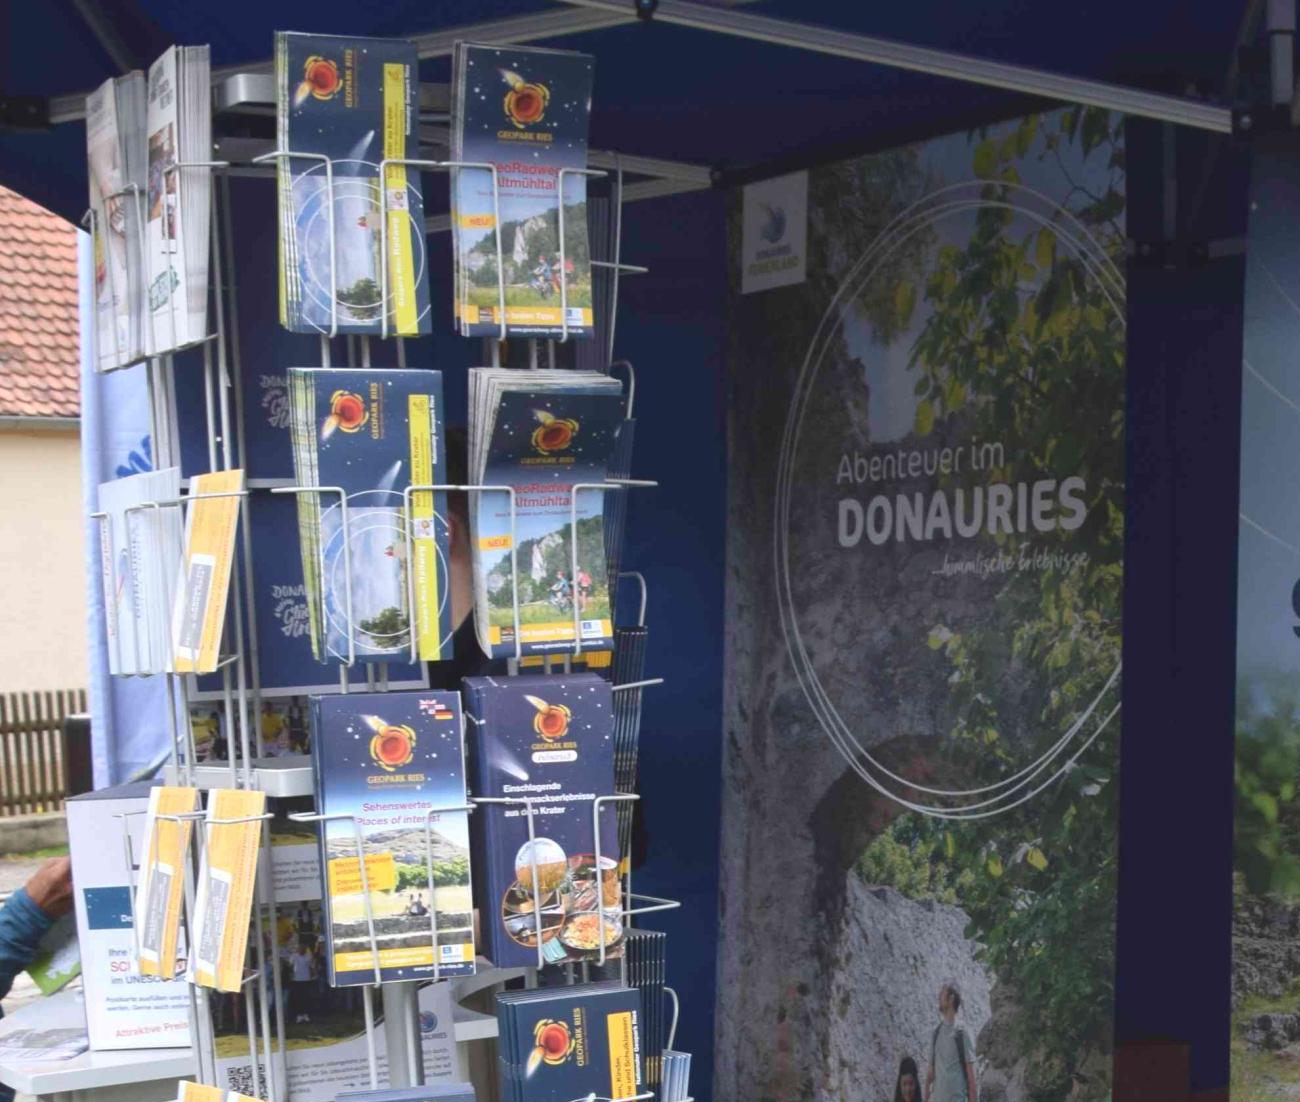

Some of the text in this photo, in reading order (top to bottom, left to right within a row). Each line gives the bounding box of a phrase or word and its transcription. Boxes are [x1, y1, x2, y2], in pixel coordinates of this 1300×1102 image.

[489, 161, 562, 178] eoRadweg
[370, 402, 379, 440] GEOPARK
[836, 435, 1004, 485] Abenteuer im
[838, 475, 1087, 548] DONAURIES
[367, 773, 425, 784] GEOPARK RIES
[362, 801, 433, 812] Sehenswertes
[539, 806, 566, 815] Krater
[357, 815, 401, 826] Places of
[164, 1021, 189, 1033] Preis
[573, 1007, 584, 1067] GEOPARK RIES
[622, 1016, 631, 1068] Schulklassen
